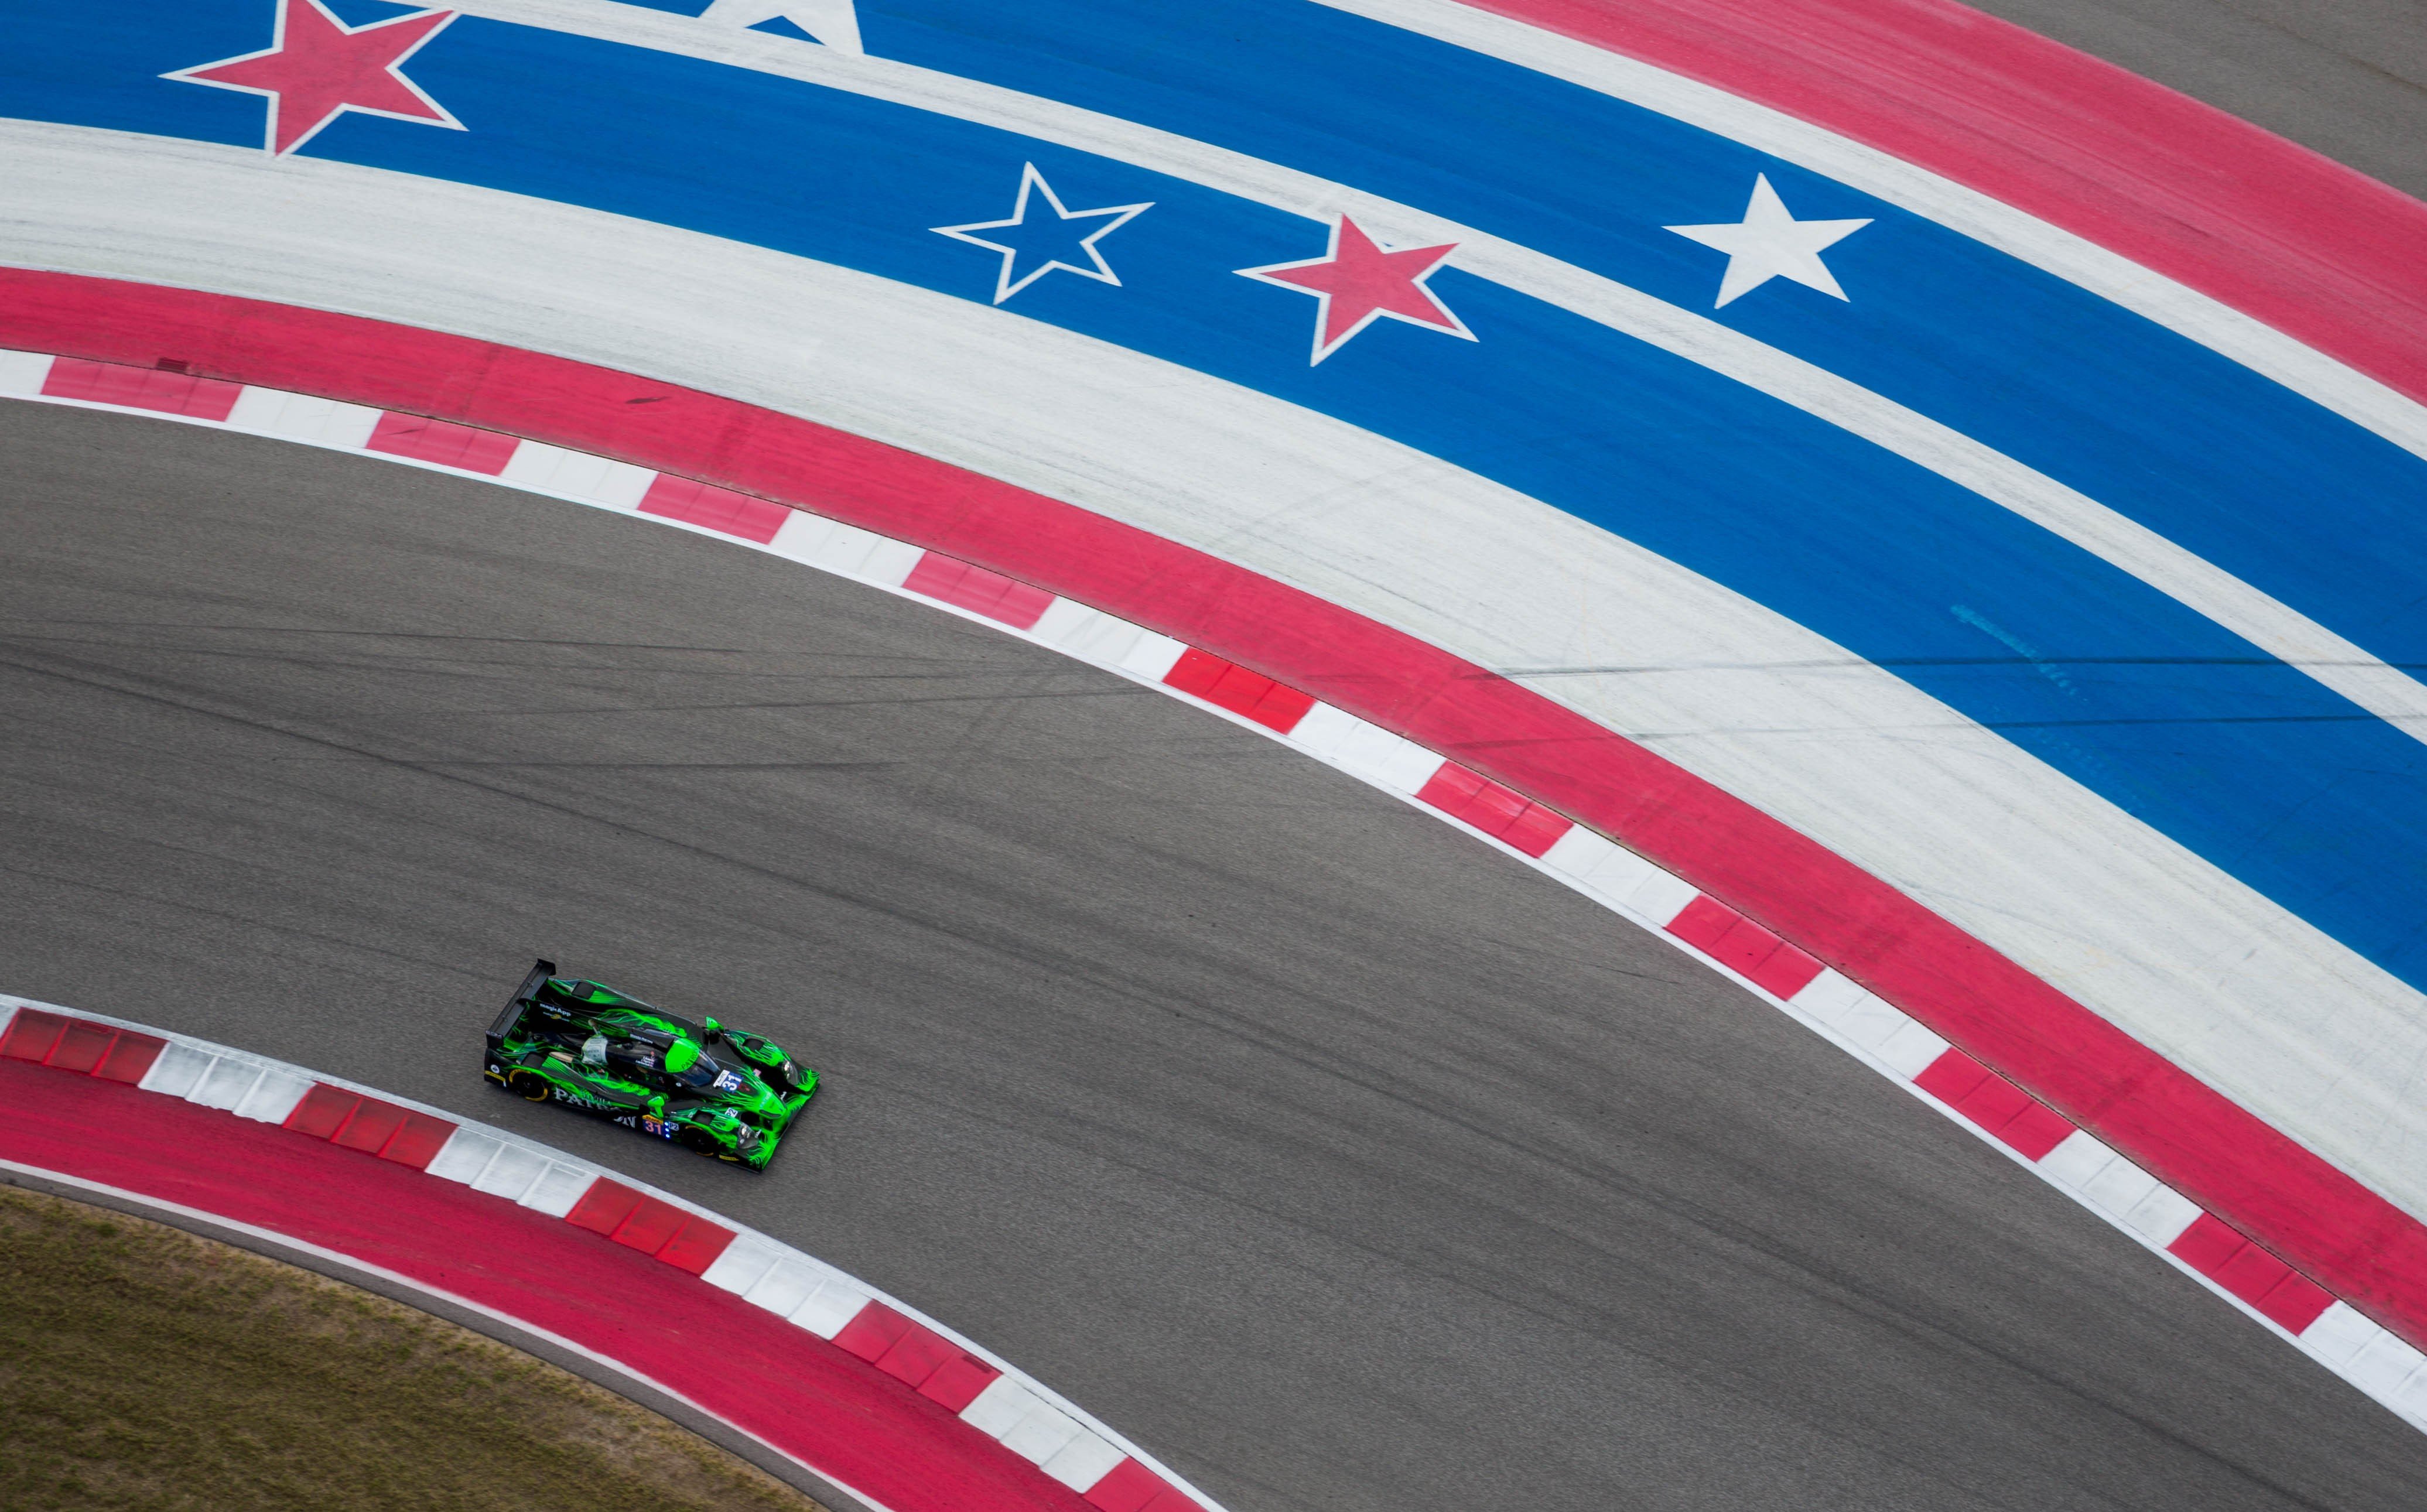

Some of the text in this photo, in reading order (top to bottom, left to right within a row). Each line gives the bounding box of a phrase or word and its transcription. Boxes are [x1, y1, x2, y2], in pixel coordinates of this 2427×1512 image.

[722, 1073, 743, 1091] 31
[645, 1121, 661, 1135] 31
[669, 1122, 679, 1130] P2
